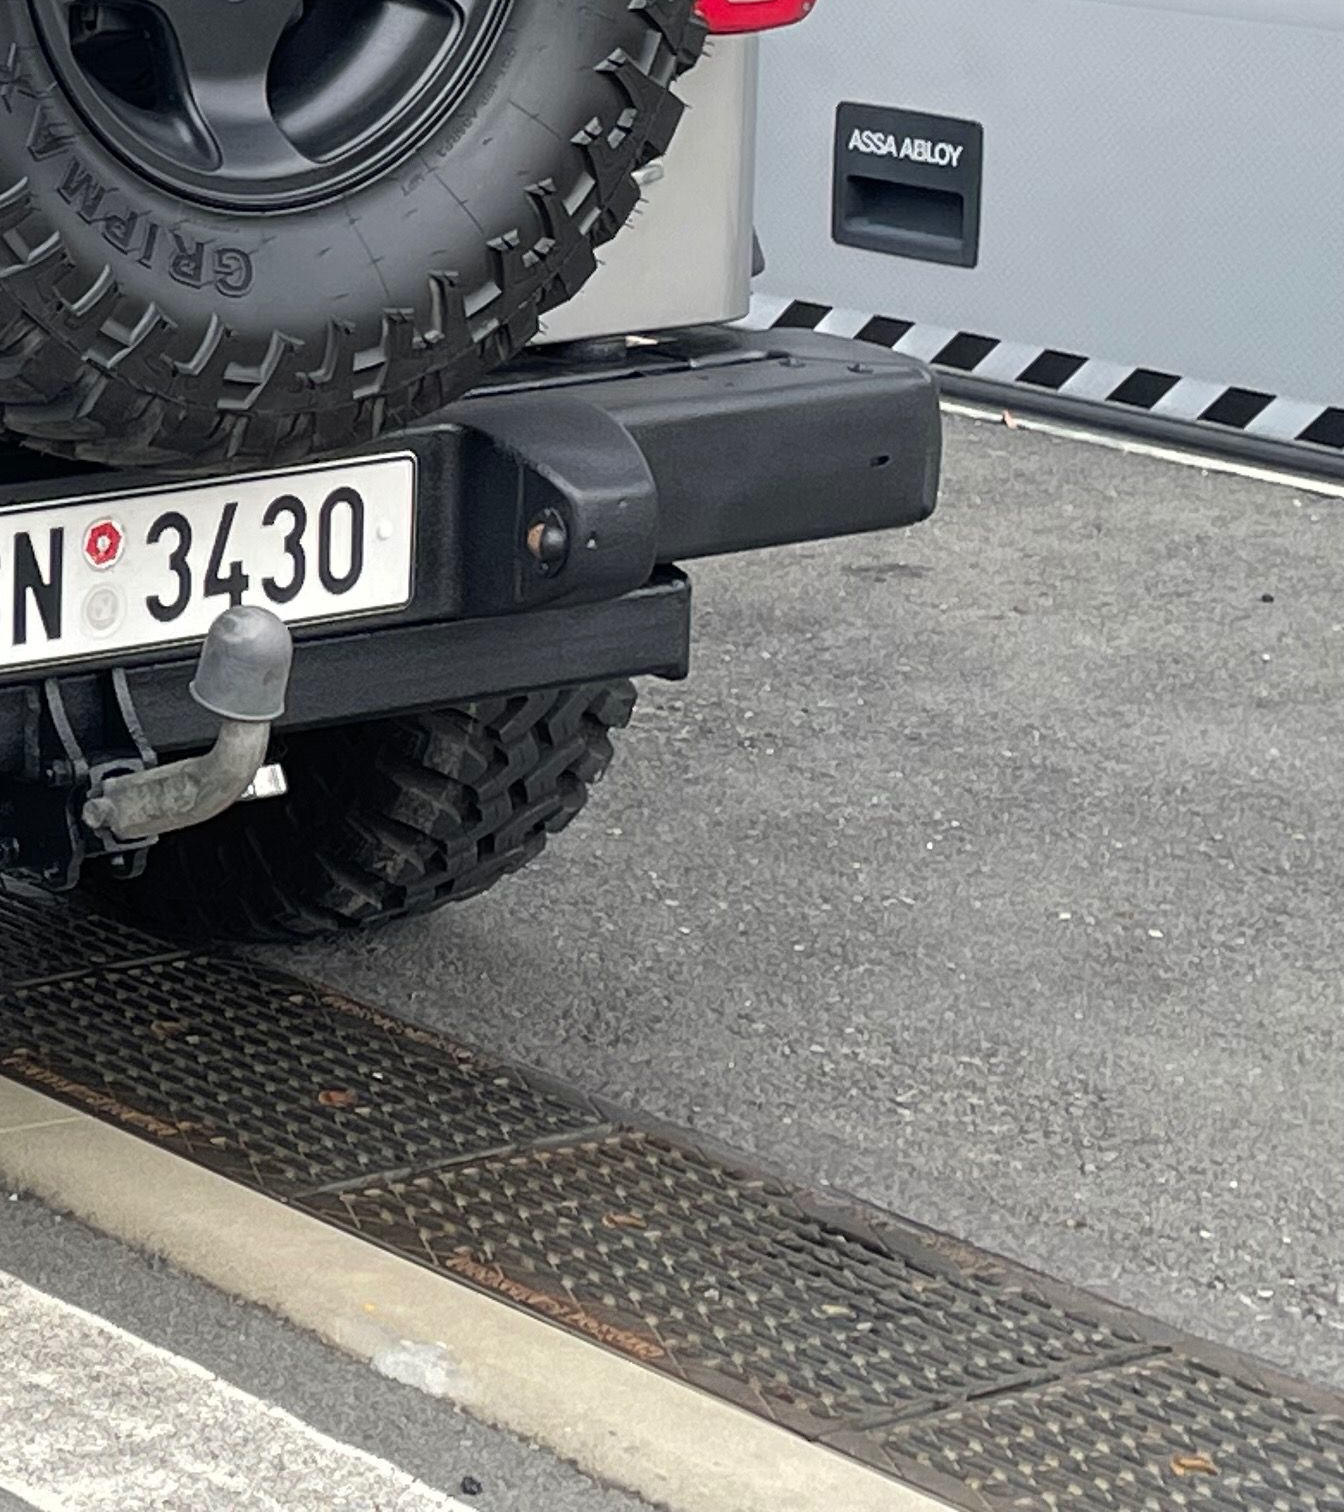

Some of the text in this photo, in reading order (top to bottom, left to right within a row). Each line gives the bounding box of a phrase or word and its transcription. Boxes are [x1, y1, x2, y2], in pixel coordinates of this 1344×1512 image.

[848, 128, 964, 168] ASSA ABLOY
[145, 486, 365, 623] 3430
